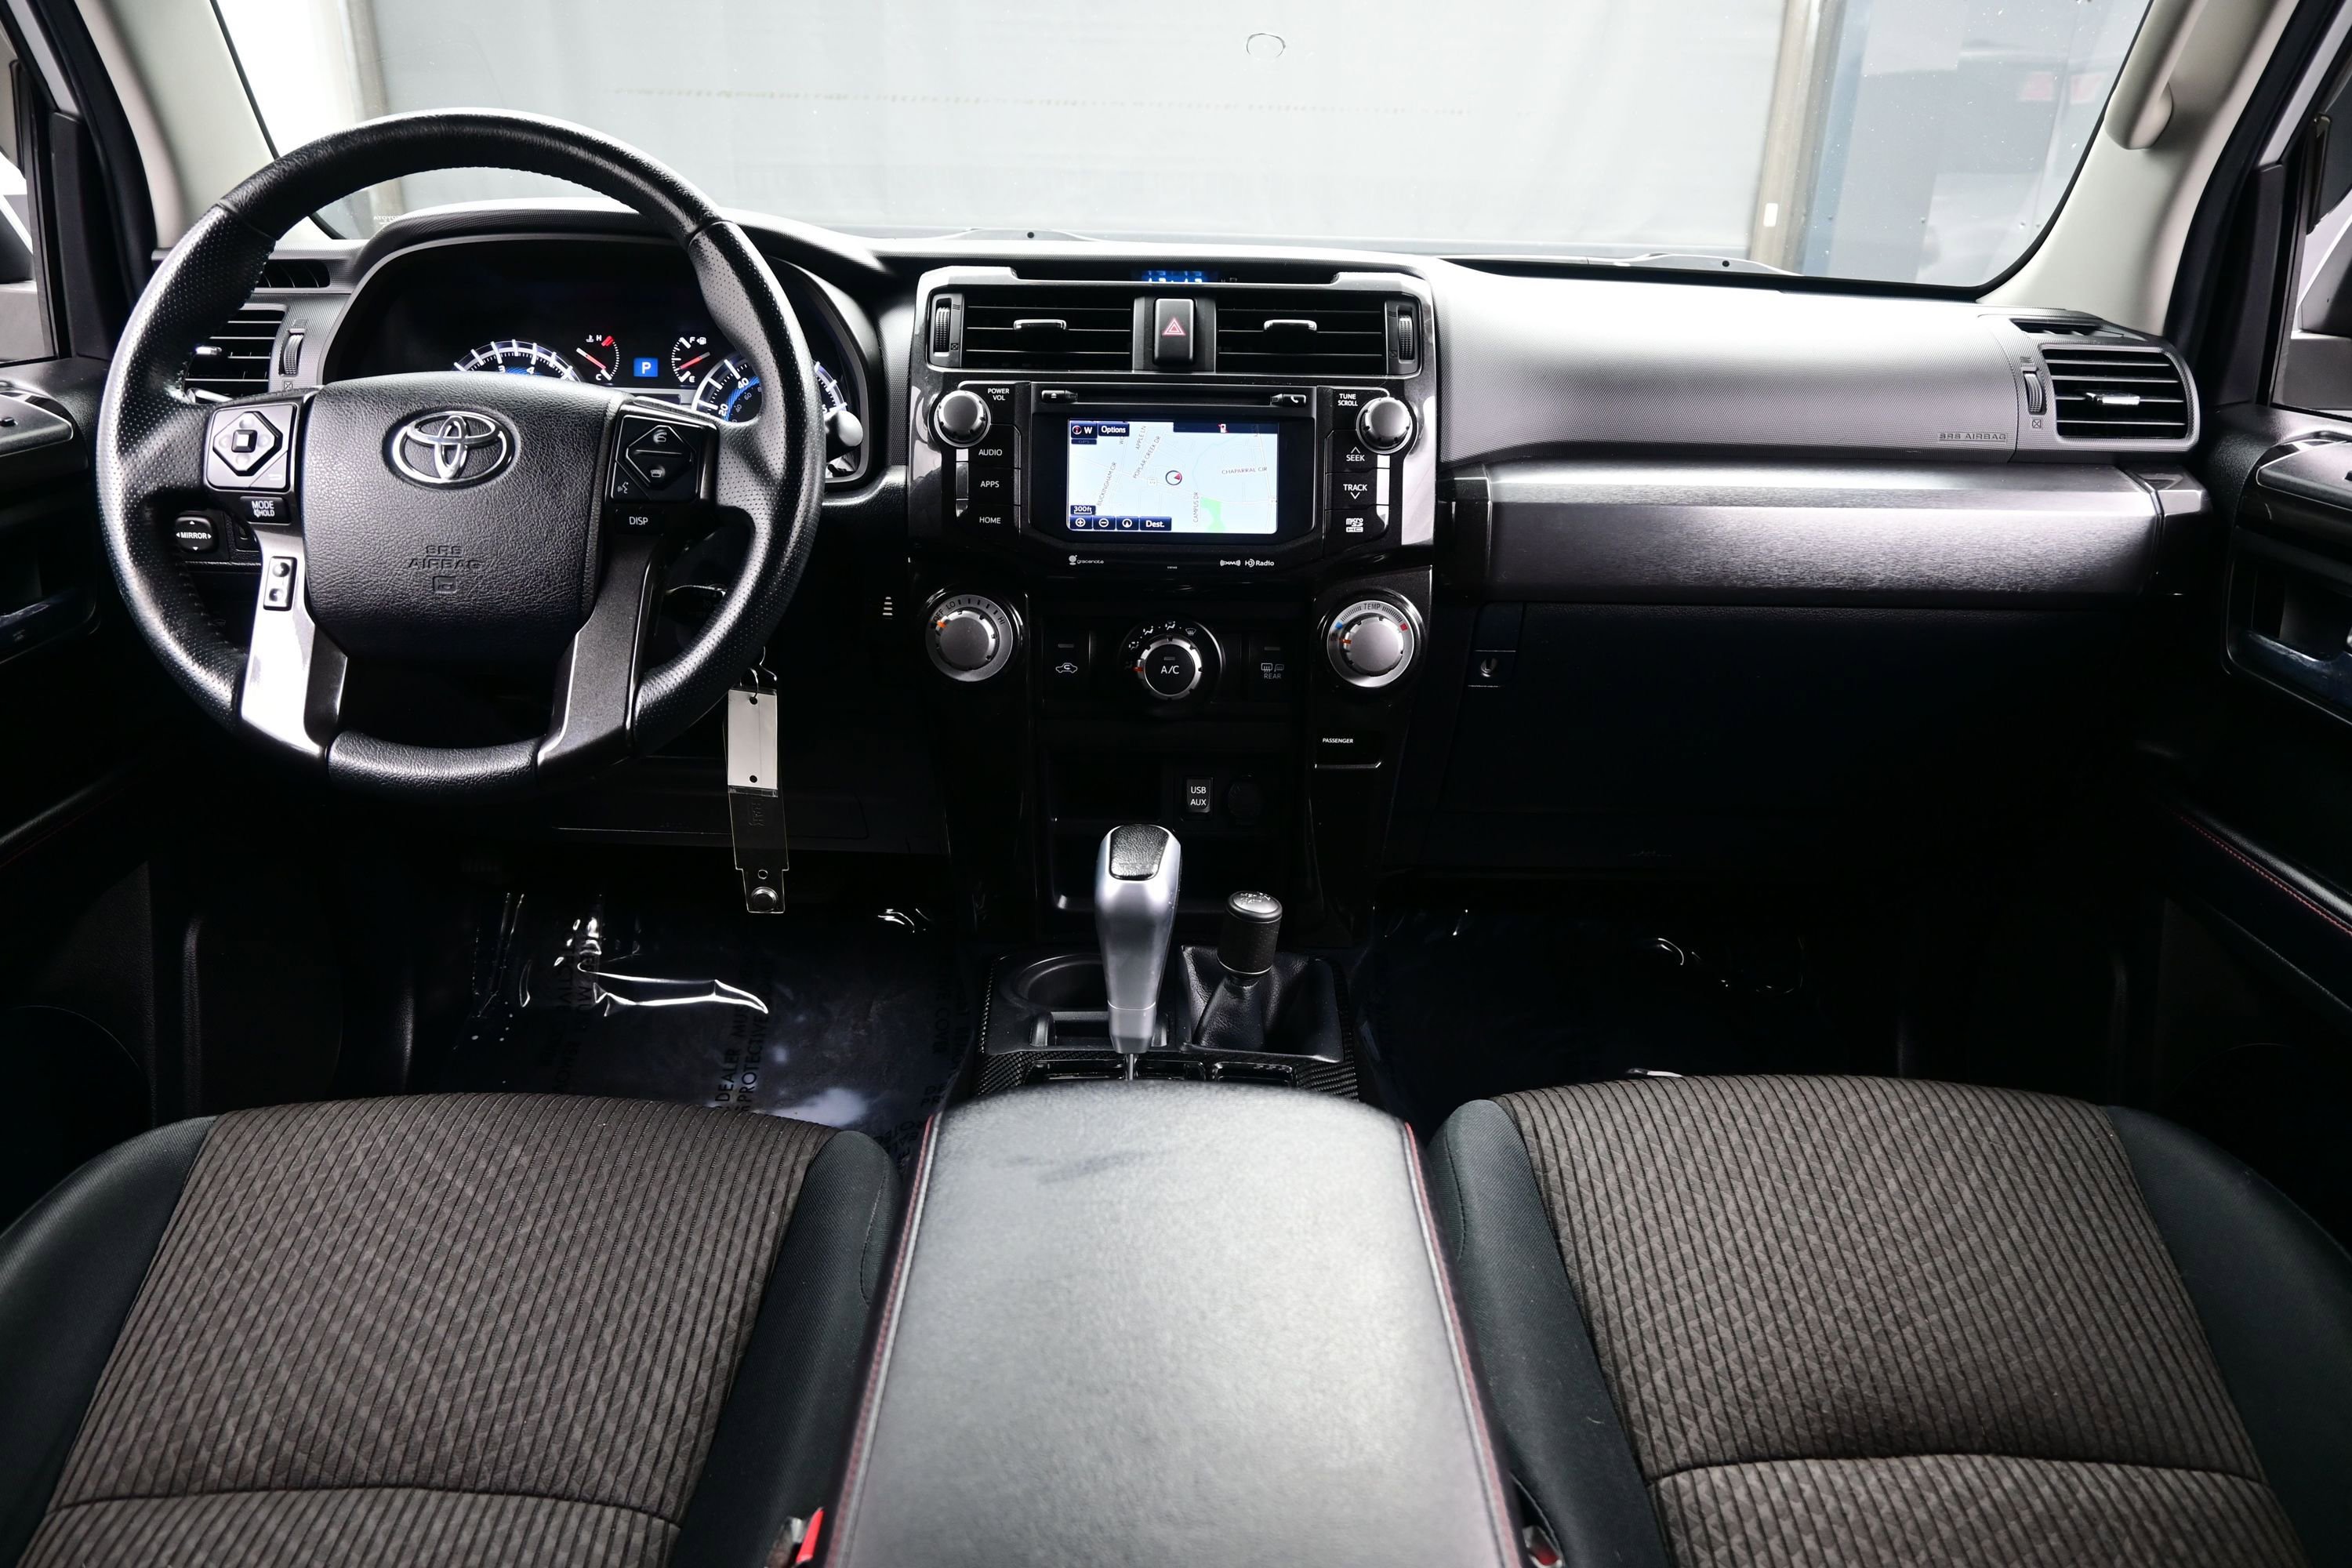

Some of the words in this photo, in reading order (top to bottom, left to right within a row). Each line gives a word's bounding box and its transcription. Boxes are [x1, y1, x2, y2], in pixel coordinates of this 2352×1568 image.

[526, 366, 535, 375] 4
[641, 362, 652, 375] P
[737, 377, 750, 390] 40
[717, 403, 730, 416] 20
[1101, 426, 1127, 436] Options
[980, 480, 1000, 488] APPS
[1343, 484, 1368, 492] TRACK
[251, 500, 275, 510] MODE
[629, 516, 649, 525] DISP
[978, 516, 1002, 524] HOME
[1145, 521, 1166, 529] Dest.
[180, 532, 208, 540] MIRROR
[946, 601, 956, 611] LO
[1363, 603, 1381, 612] TEMP
[932, 609, 945, 622] OFF
[997, 616, 1006, 626] HI
[1160, 665, 1181, 675] A/C
[1190, 786, 1207, 794] USB
[1189, 798, 1207, 807] AUX
[735, 1014, 769, 1104] PROTECTIVE
[714, 1047, 742, 1102] DEALER
